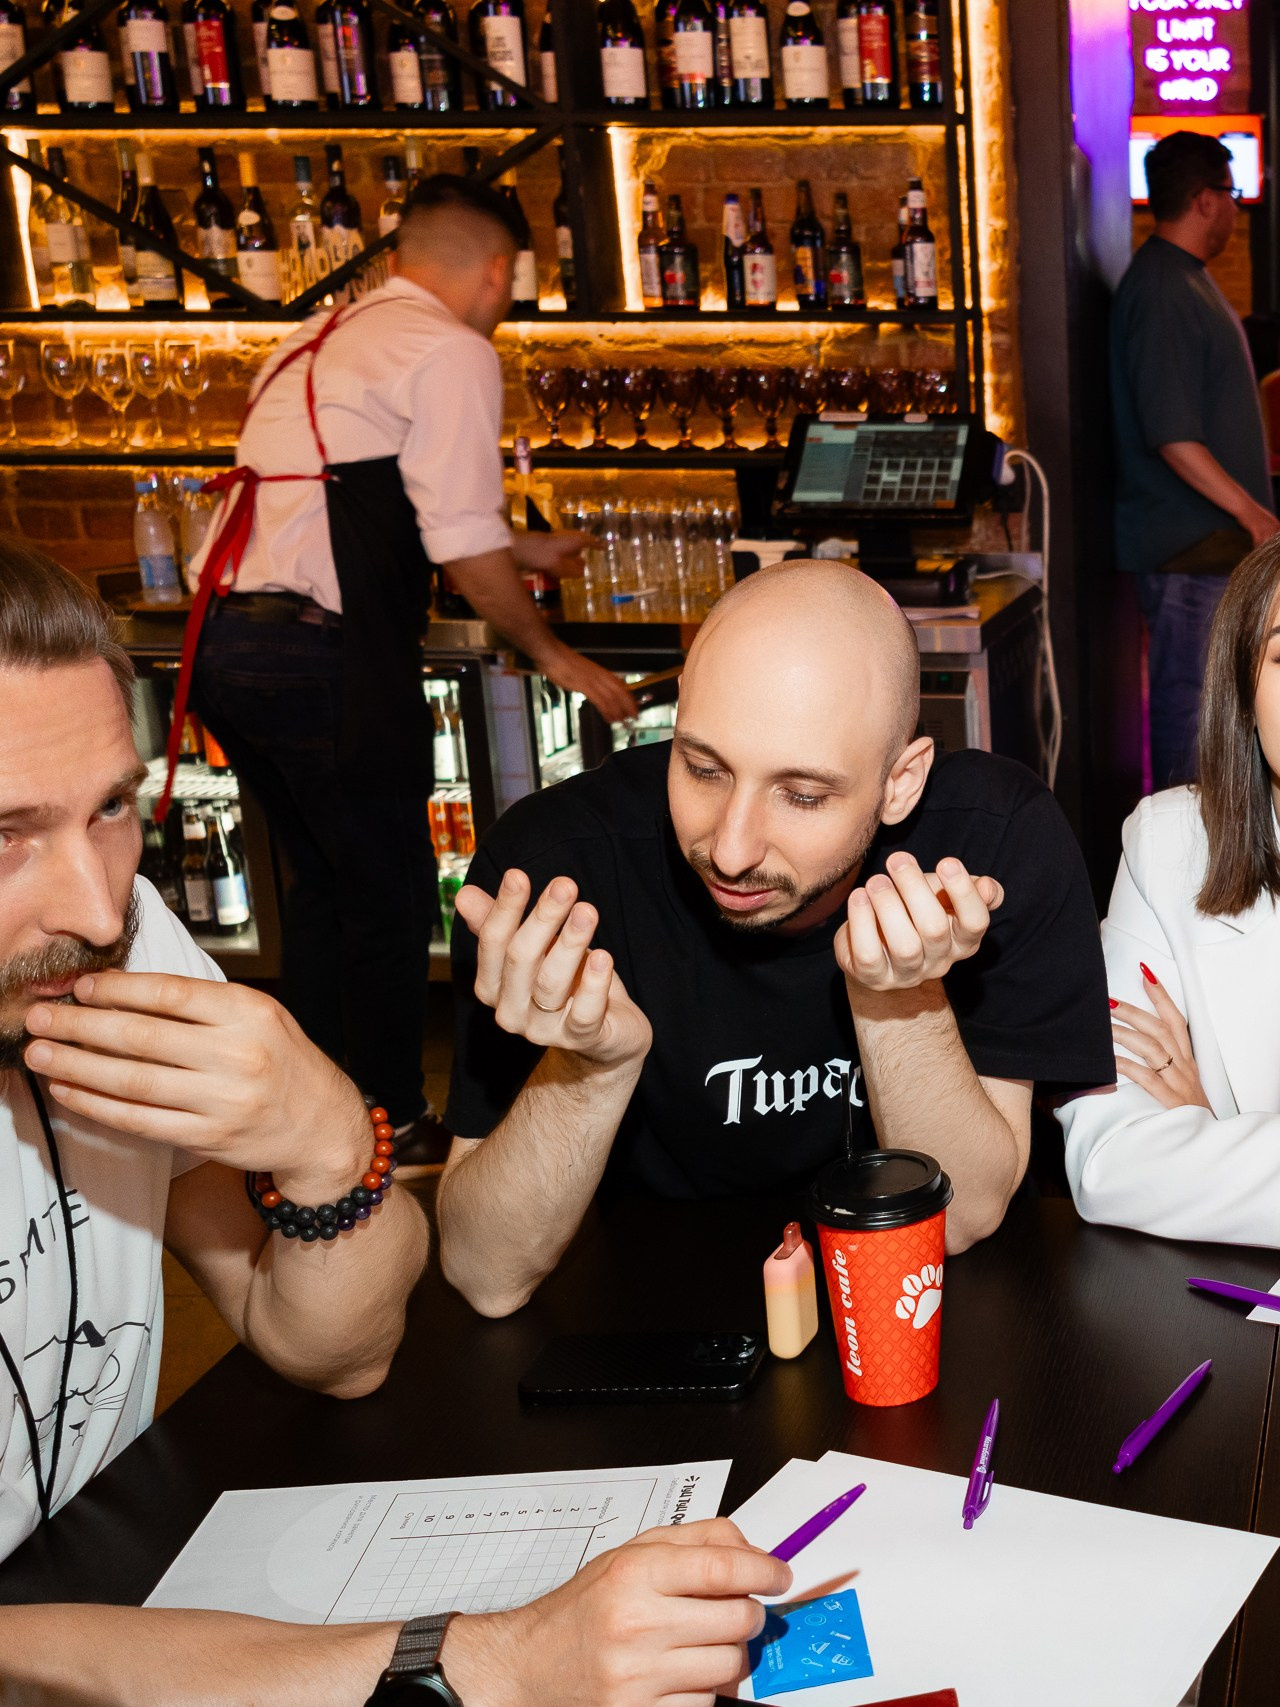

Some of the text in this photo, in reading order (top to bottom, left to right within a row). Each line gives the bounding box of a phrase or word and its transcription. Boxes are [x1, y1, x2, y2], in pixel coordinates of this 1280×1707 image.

[1171, 49, 1229, 71] YOUR
[832, 1248, 864, 1378] leon cafe
[424, 1514, 436, 1523] 10
[598, 1496, 613, 1520] Вопросы
[400, 1512, 415, 1530] Сумма
